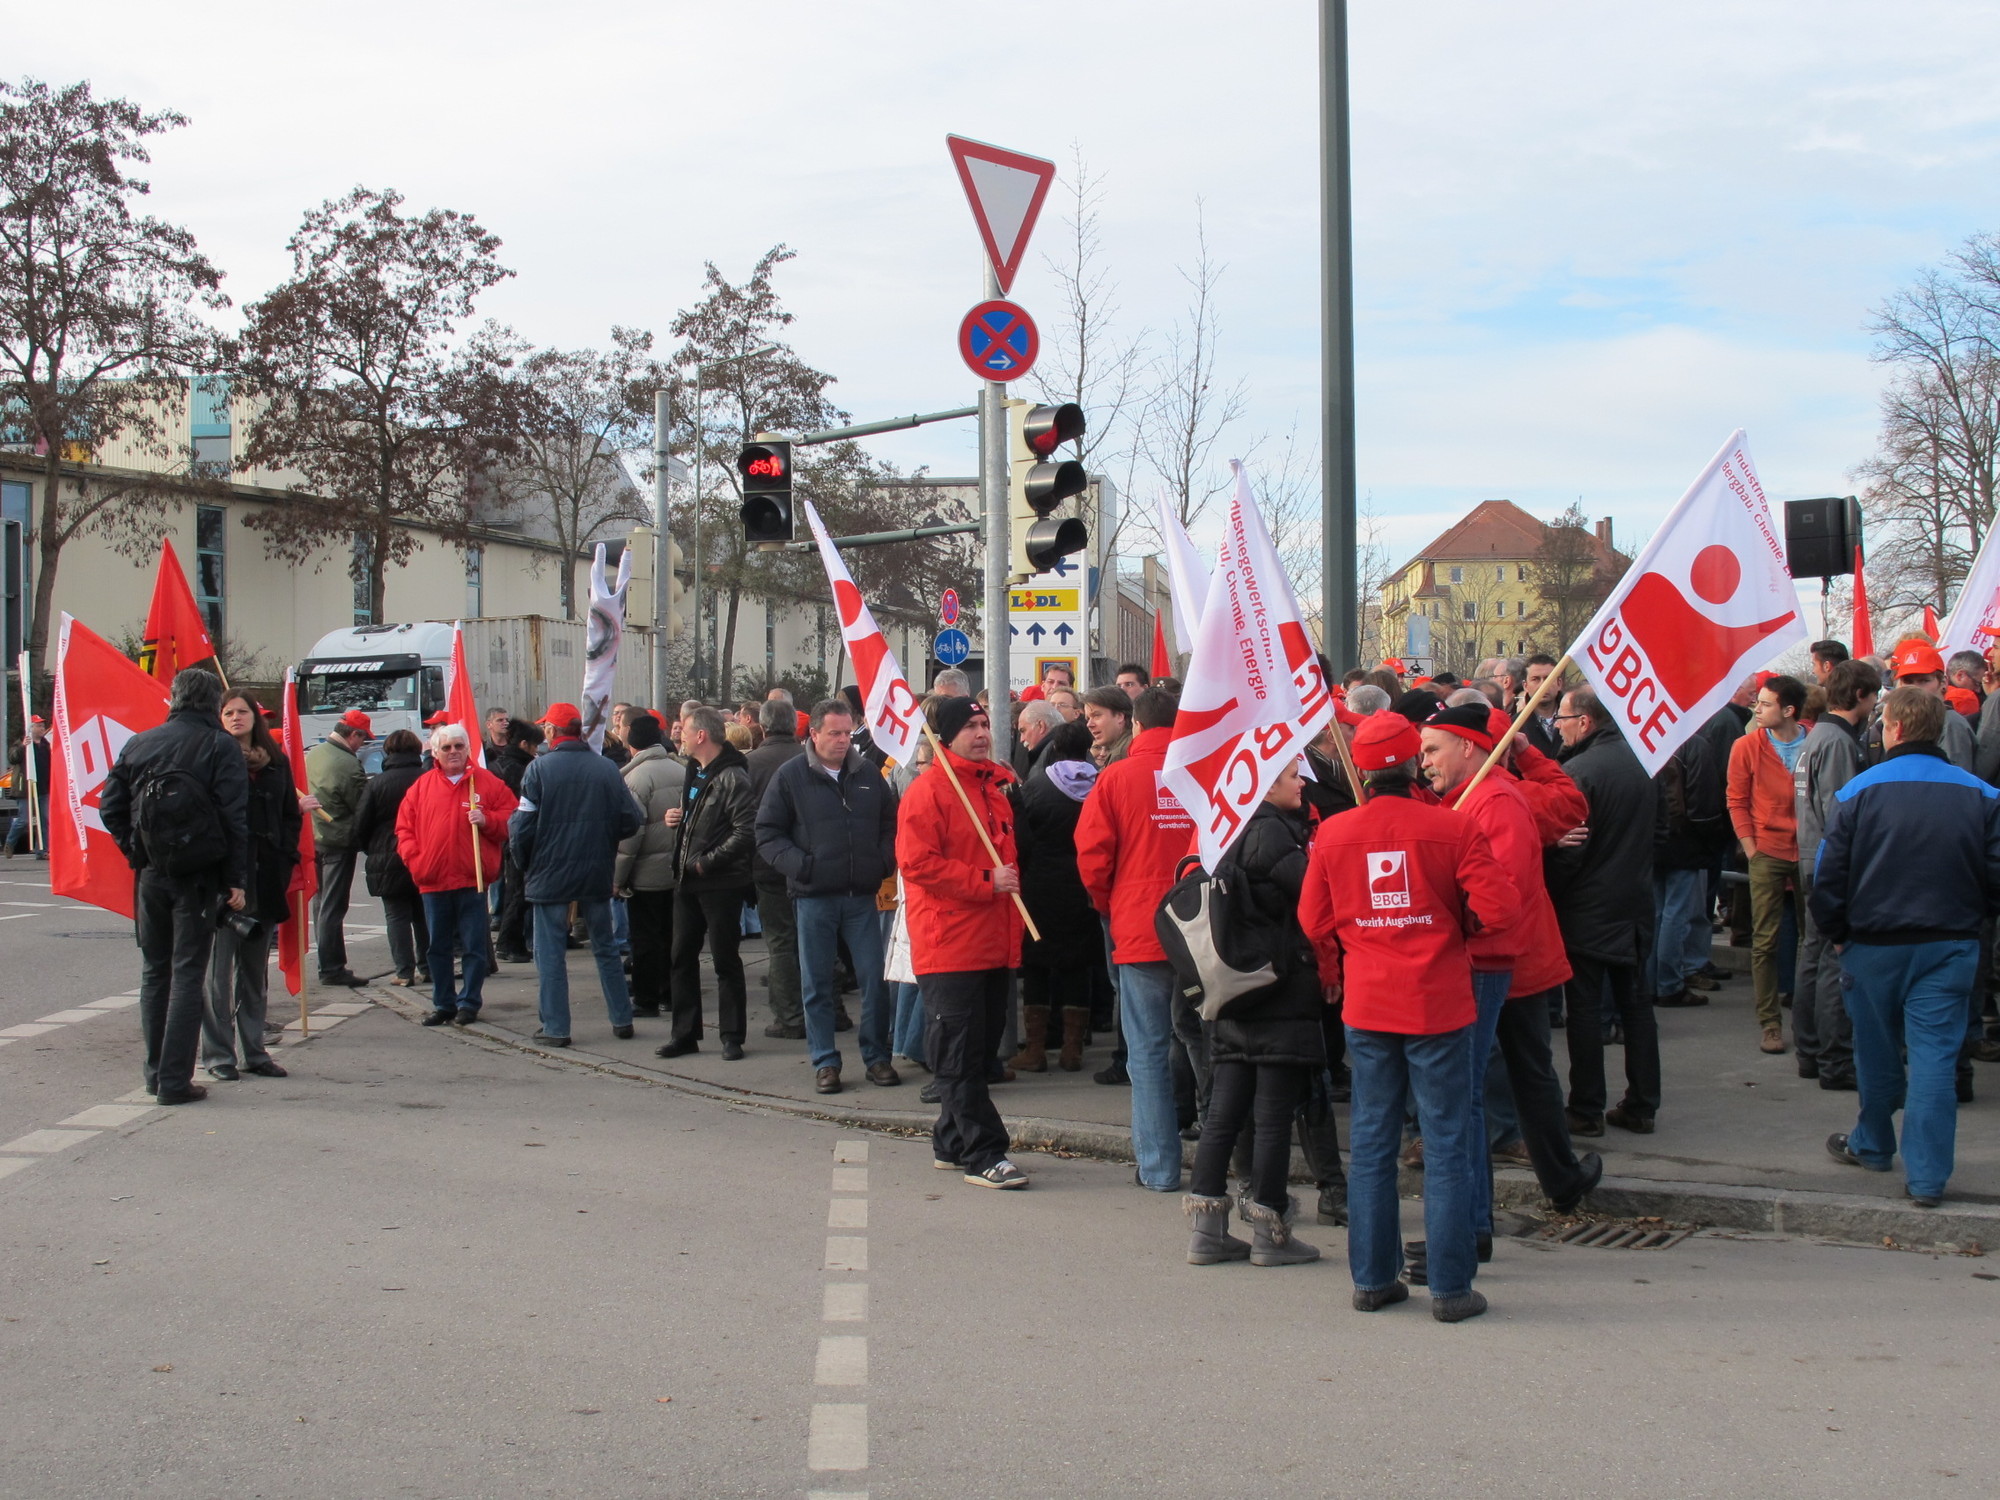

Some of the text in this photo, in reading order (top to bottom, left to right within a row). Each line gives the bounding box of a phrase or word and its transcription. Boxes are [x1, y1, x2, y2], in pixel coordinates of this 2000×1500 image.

[1721, 461, 1755, 513] Bergbau,
[1226, 570, 1246, 636] Chemie,
[1239, 638, 1267, 700] Energie
[1355, 914, 1433, 928] Bezirk Augsburg
